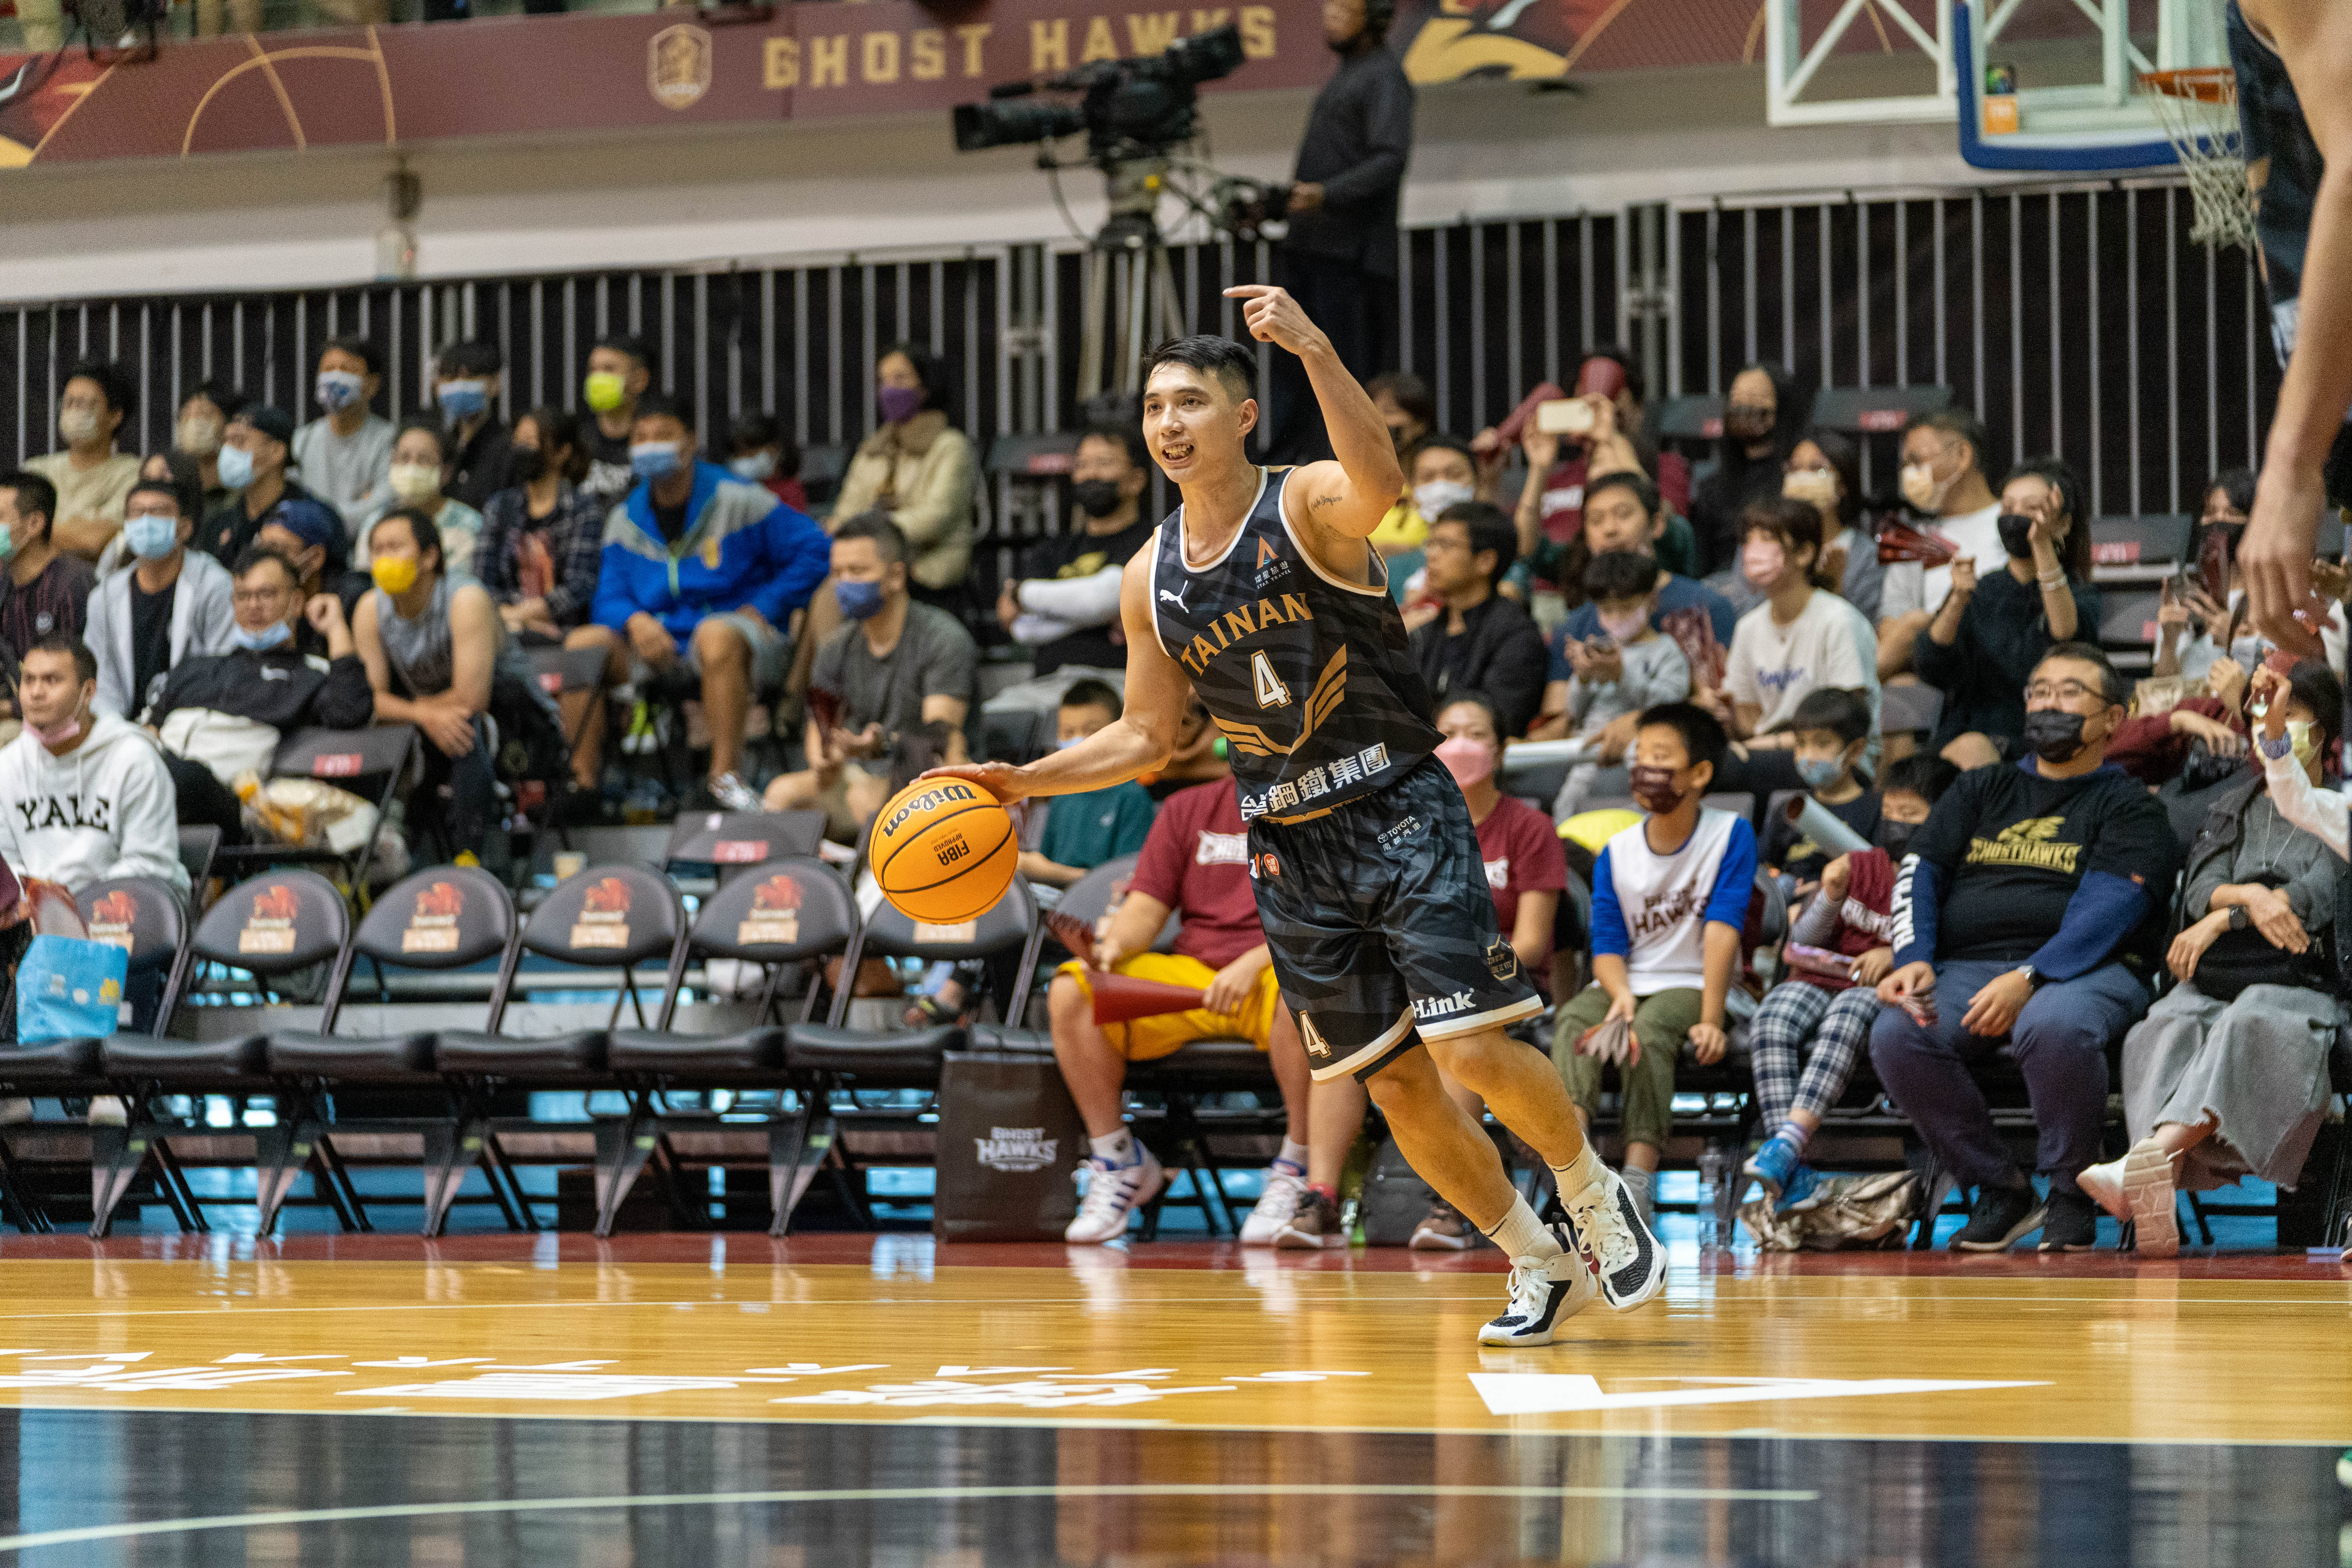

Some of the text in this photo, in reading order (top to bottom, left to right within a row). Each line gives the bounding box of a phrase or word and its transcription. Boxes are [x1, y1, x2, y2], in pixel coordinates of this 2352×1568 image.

[763, 23, 992, 89] GHOST
[1257, 569, 1291, 589] STAR TRAVEL
[1181, 592, 1314, 677] TAINAN
[1251, 649, 1292, 709] 4
[15, 793, 109, 833] YALE
[883, 784, 977, 838] Wilson
[1382, 822, 1421, 852] 南都汽車
[1387, 815, 1416, 837] TOYOTA
[934, 833, 962, 852] APPROVED
[937, 840, 970, 866] FIBA
[1410, 991, 1477, 1019] -Link
[1299, 1009, 1332, 1058] 4
[974, 1138, 1059, 1163] HAWKS
[746, 1363, 1372, 1382] STAR
